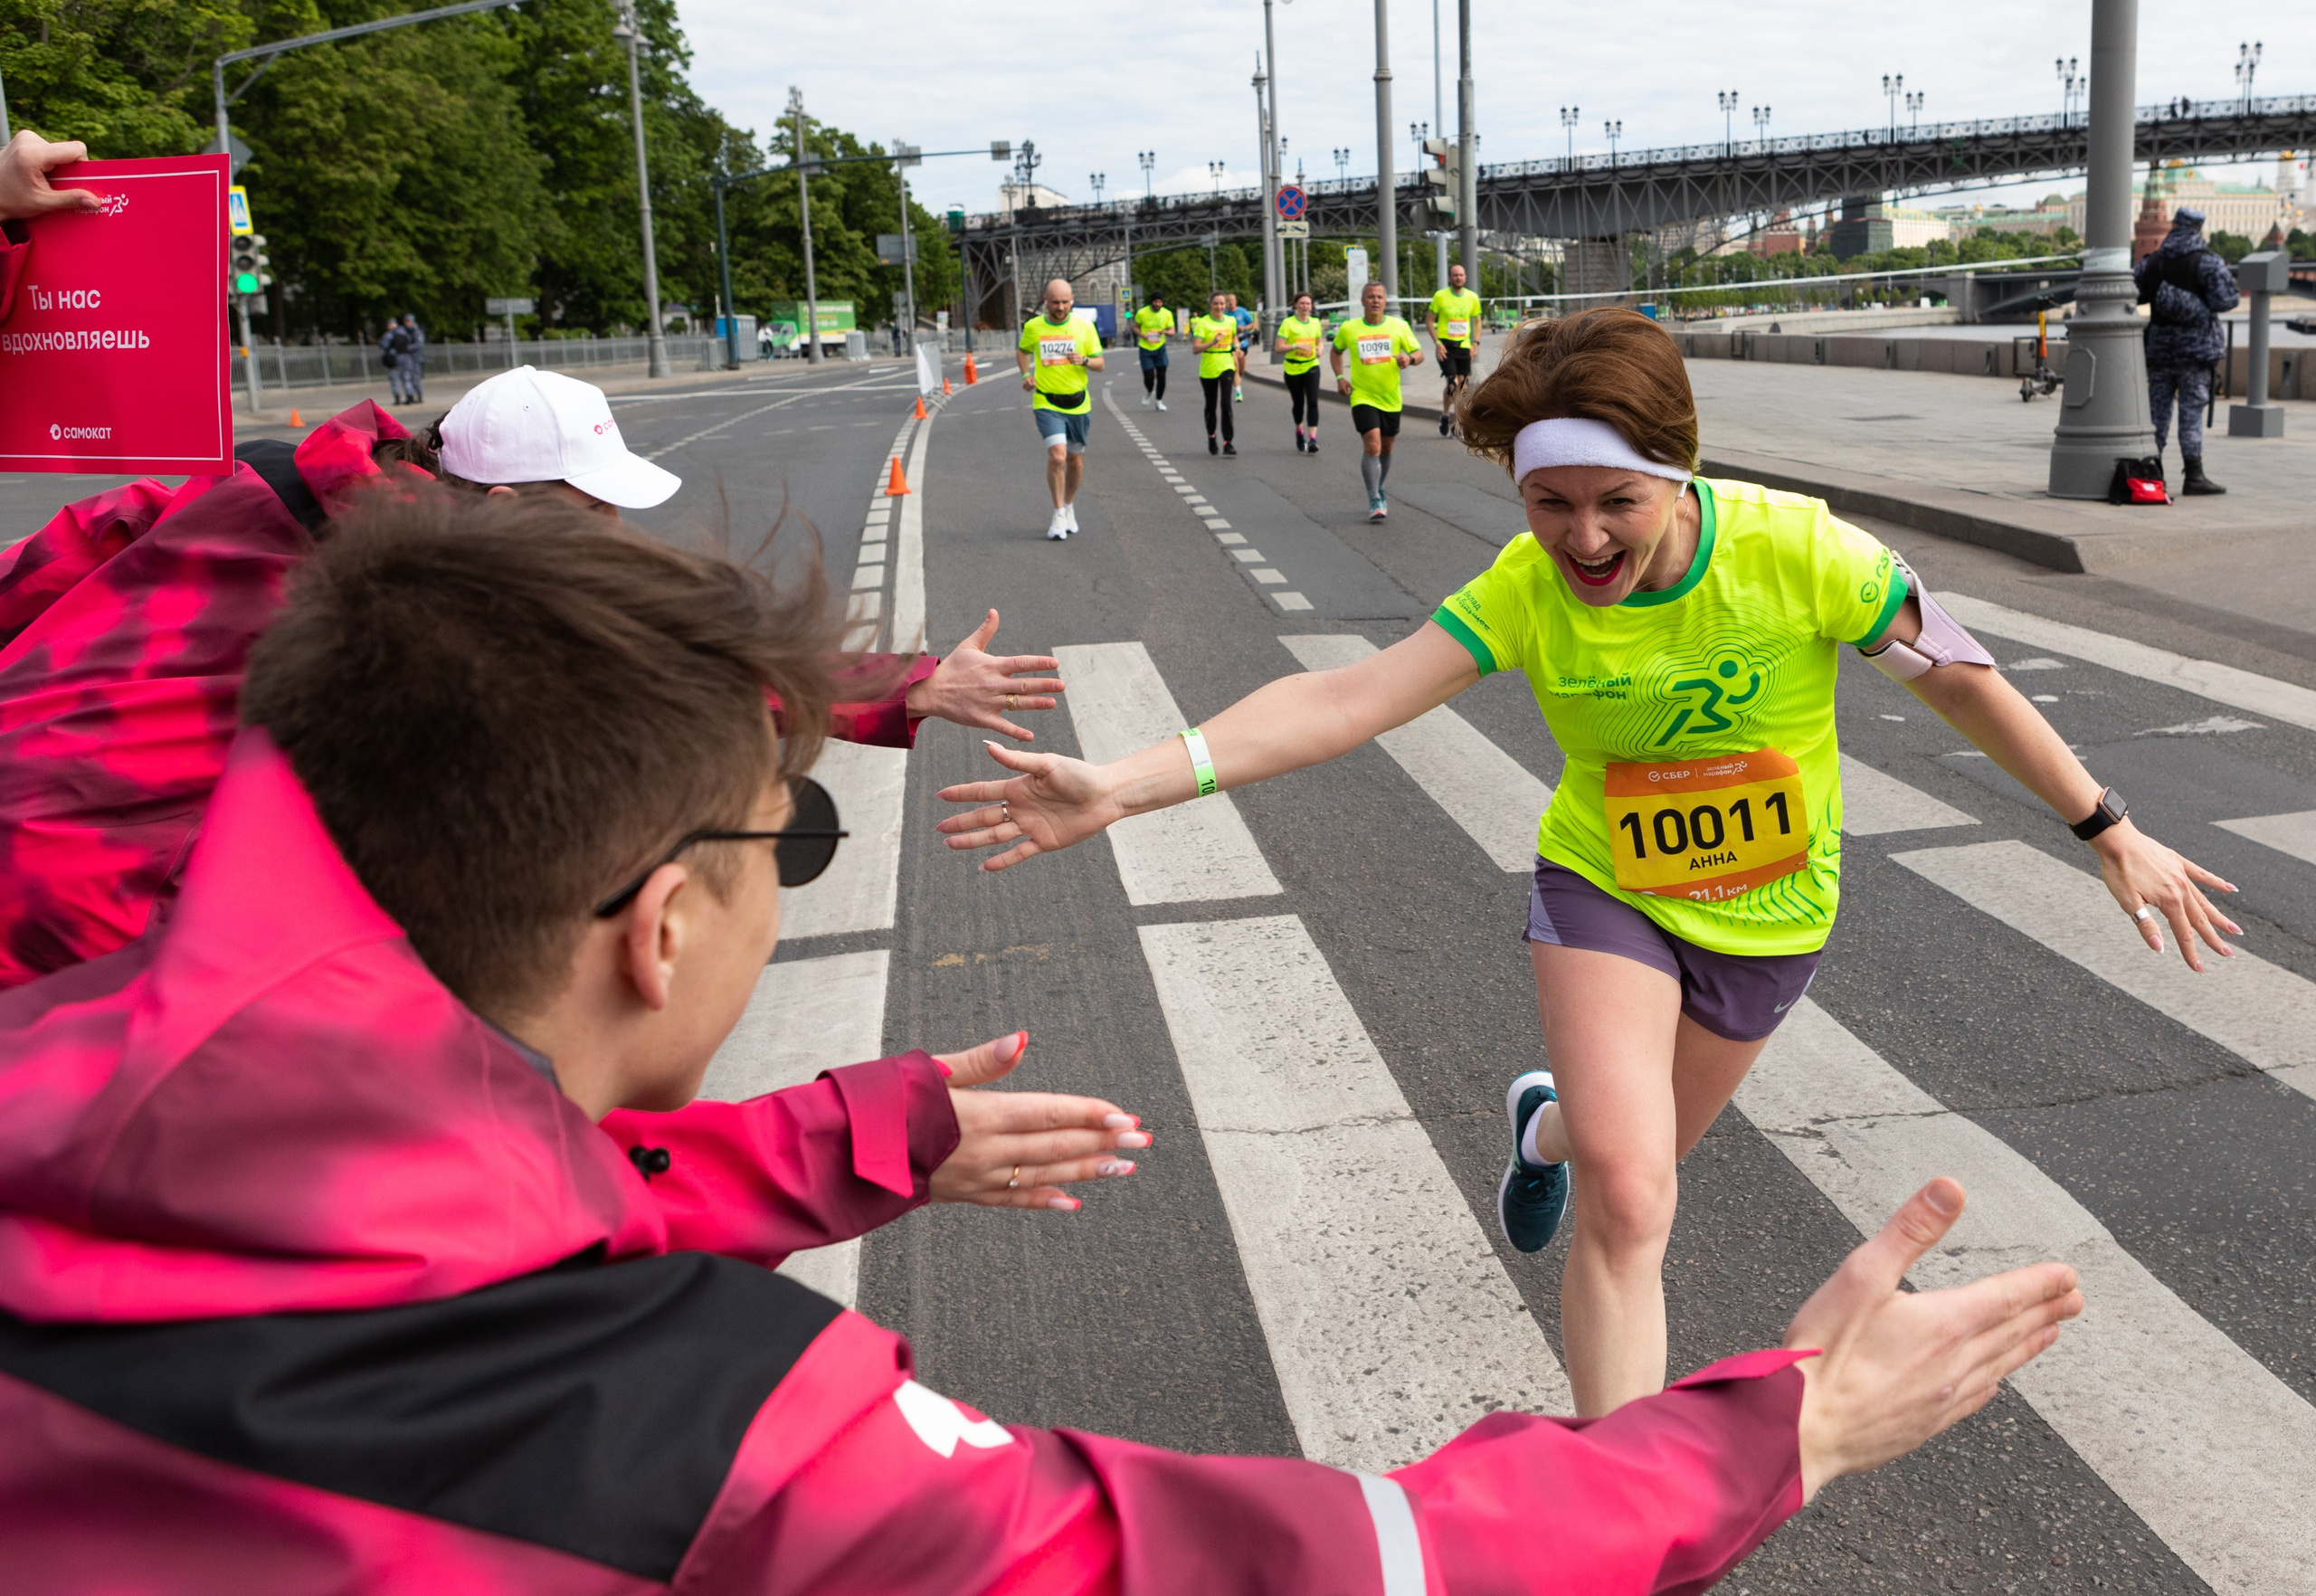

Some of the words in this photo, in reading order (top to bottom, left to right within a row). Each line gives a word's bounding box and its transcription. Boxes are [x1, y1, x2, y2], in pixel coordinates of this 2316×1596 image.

[27, 284, 53, 310] Ты
[58, 289, 101, 309] нас
[2, 329, 151, 356] вдохновляешь
[1041, 342, 1073, 354] 10274
[1361, 341, 1390, 353] 10098
[63, 426, 112, 440] самокат
[1558, 671, 1632, 689] зелёный
[1662, 770, 1691, 780] СБЕР
[1201, 778, 1216, 797] 10
[1618, 791, 1791, 860] 10011
[1689, 850, 1738, 870] АННА
